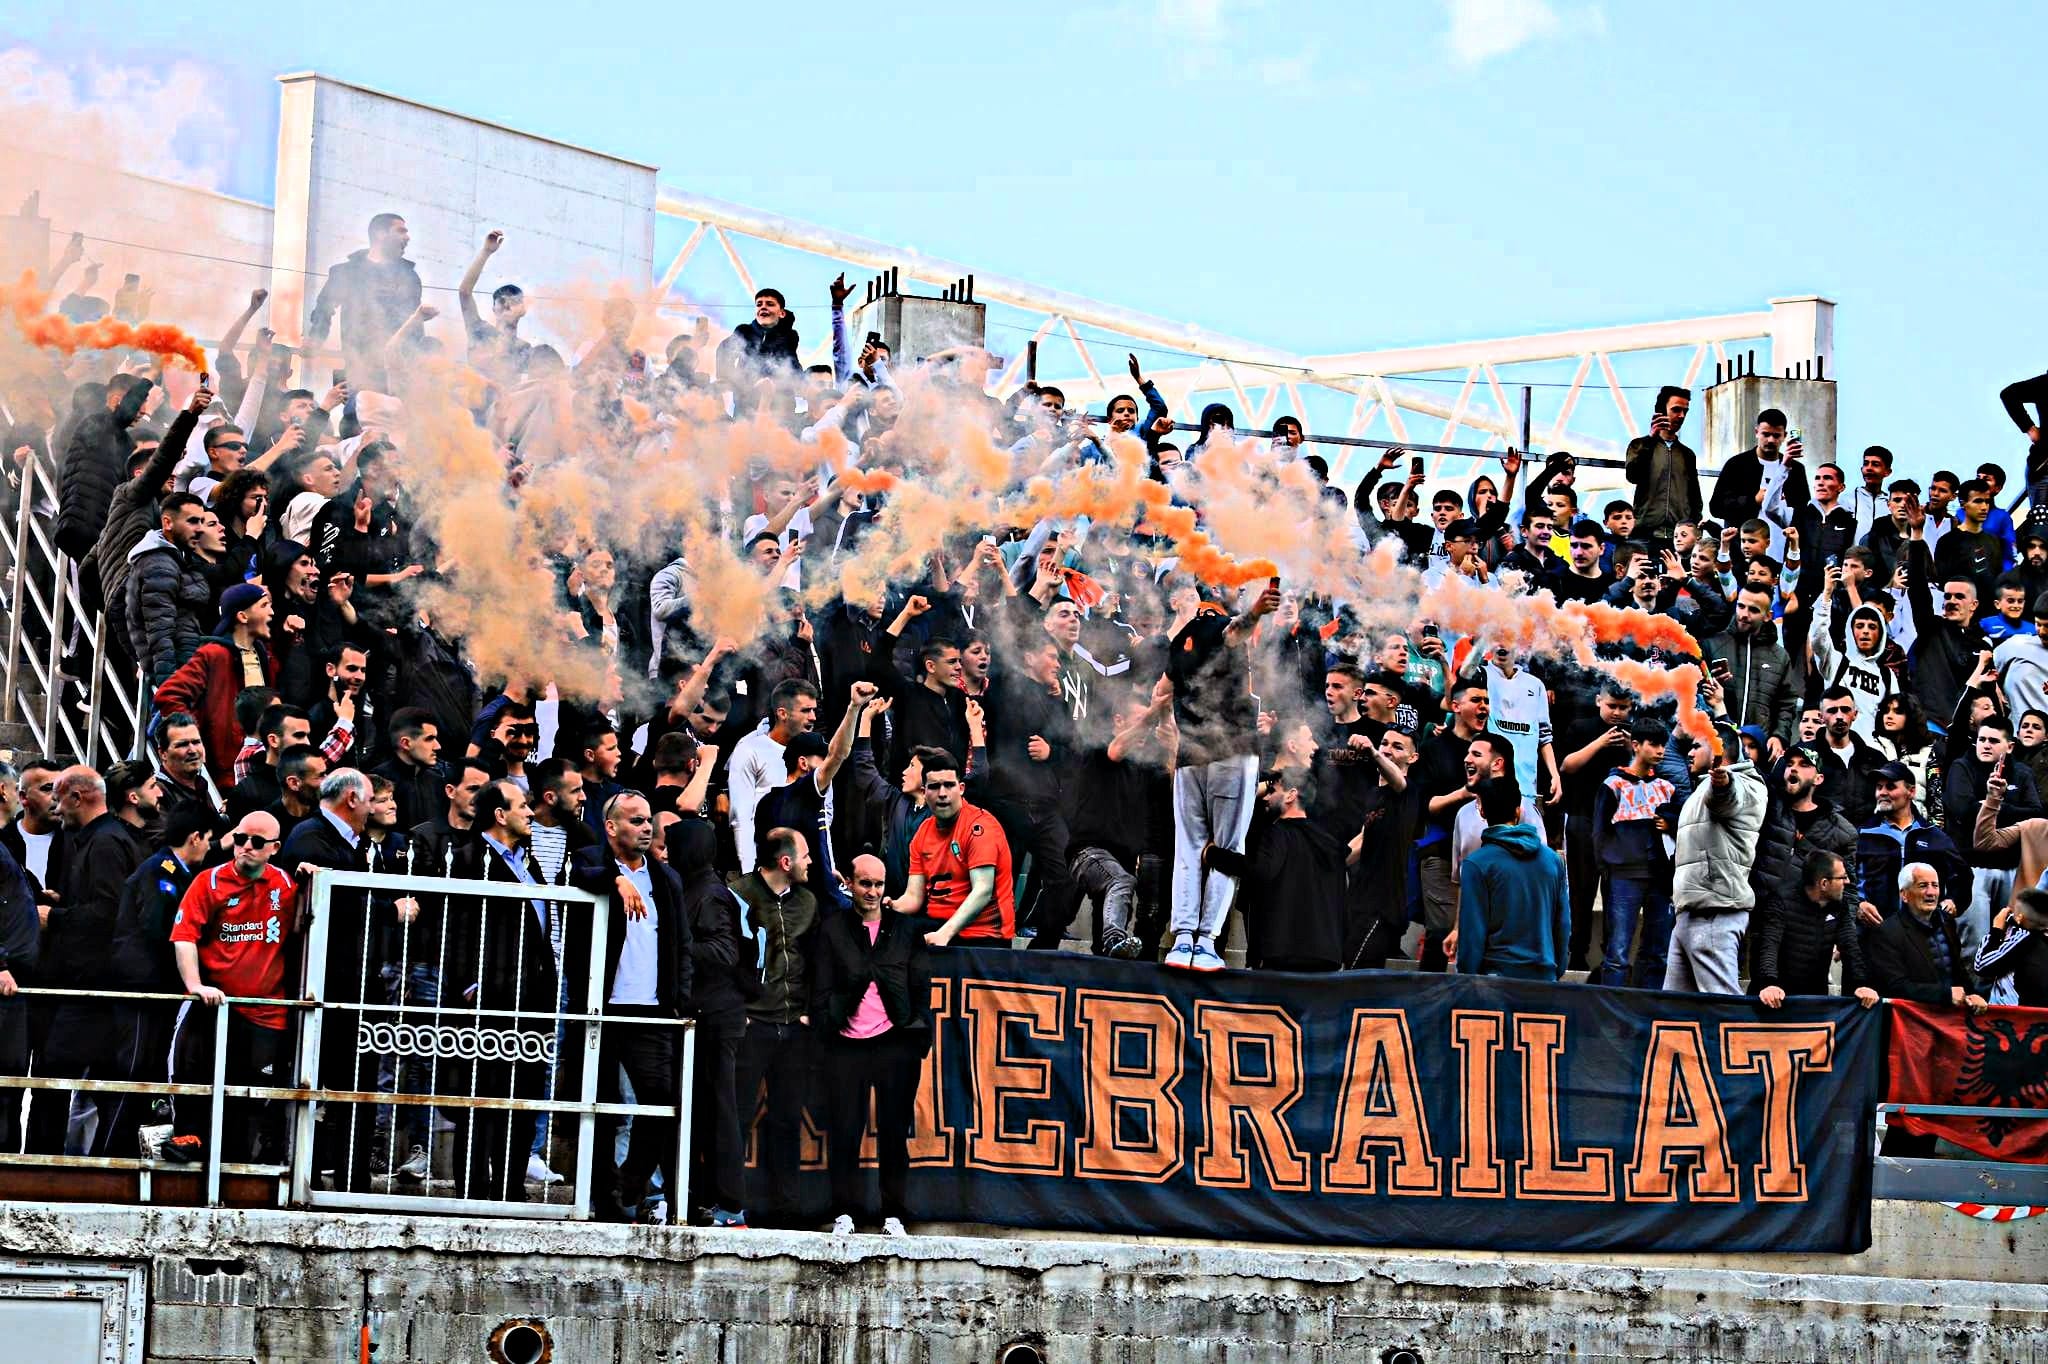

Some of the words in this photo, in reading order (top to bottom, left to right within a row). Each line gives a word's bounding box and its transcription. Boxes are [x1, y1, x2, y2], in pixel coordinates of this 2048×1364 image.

[1848, 665, 1880, 697] THE
[219, 932, 264, 942] Chartered
[222, 921, 264, 932] Standard
[743, 976, 1836, 1203] EBRAILAT
